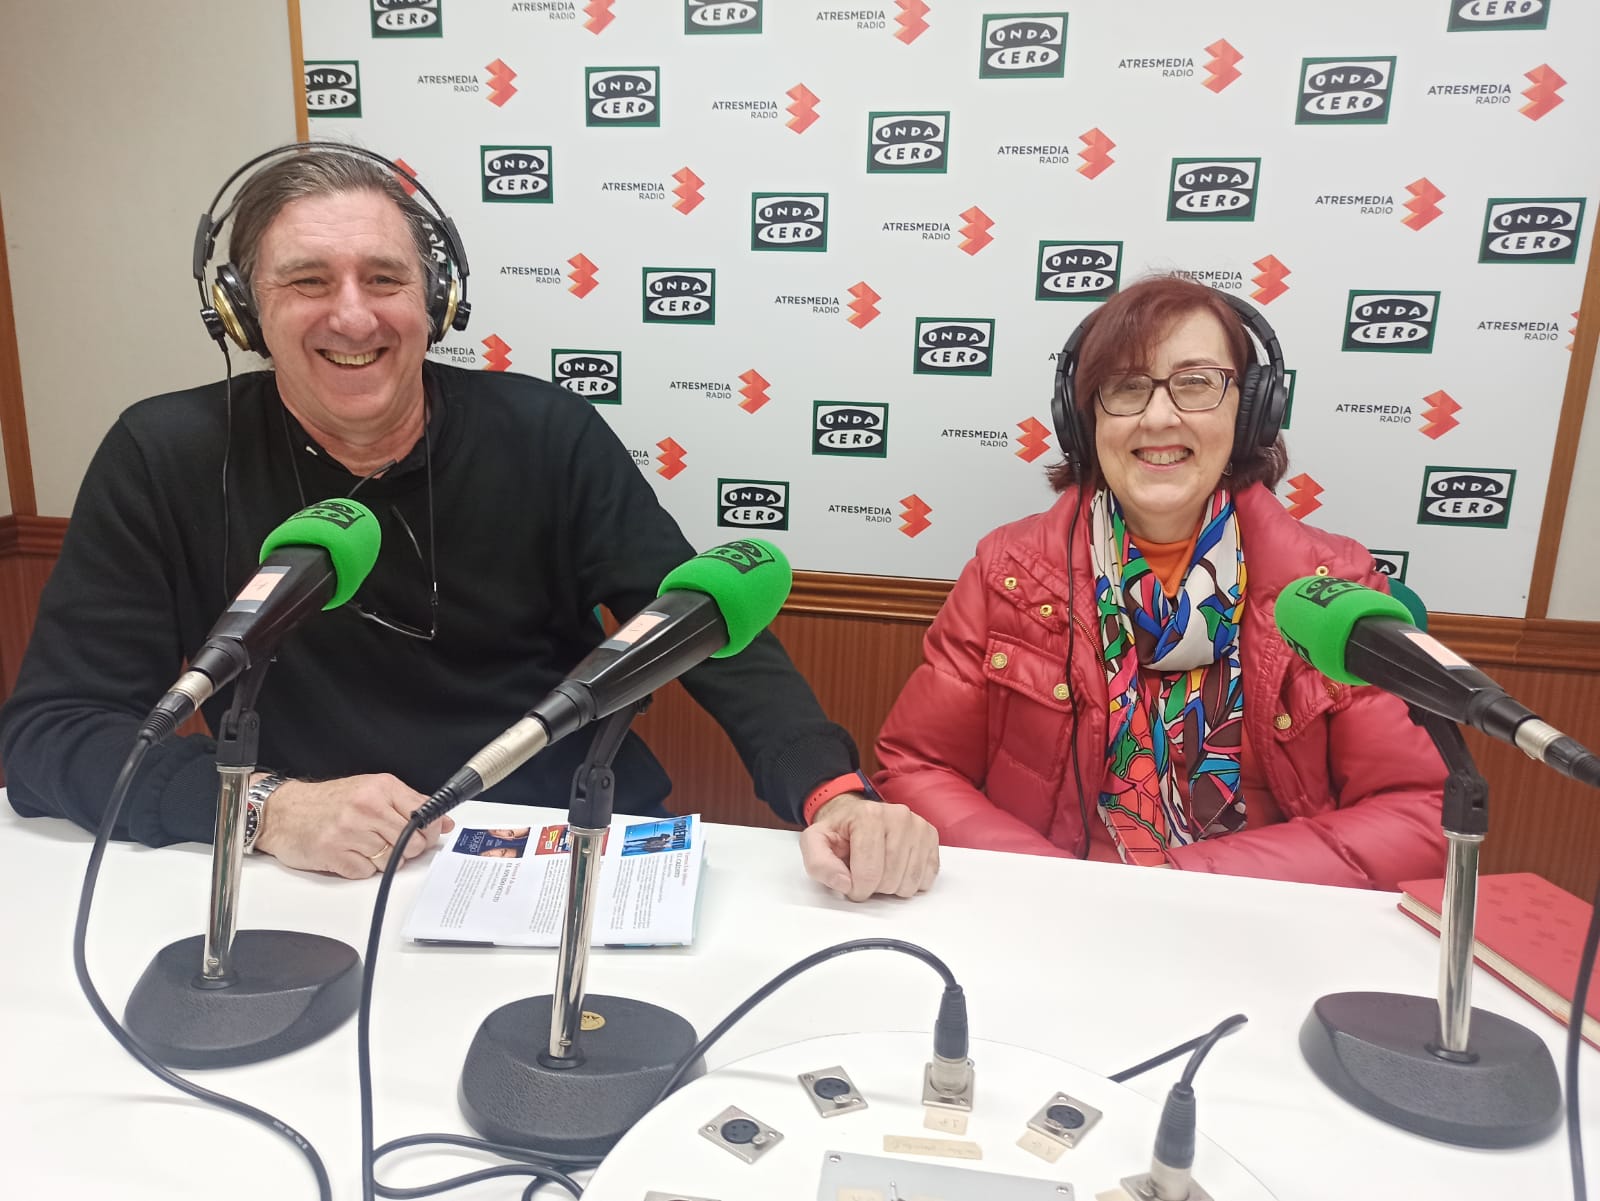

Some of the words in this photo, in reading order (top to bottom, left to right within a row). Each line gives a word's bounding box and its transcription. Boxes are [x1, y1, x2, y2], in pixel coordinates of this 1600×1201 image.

[512, 2, 575, 12] ATRESMEDIA
[1471, 1, 1531, 15] CERO
[386, 13, 428, 25] CERO
[549, 12, 576, 20] RADIO
[701, 8, 748, 20] CERO
[816, 10, 885, 20] ATRESMEDIA
[857, 20, 886, 29] RADIO
[996, 29, 1050, 41] ONDA
[998, 51, 1049, 64] CERO
[1118, 58, 1194, 68] ATRESMEDIA
[1162, 69, 1194, 77] RADIO
[418, 75, 478, 84] ATRESMEDIA
[1316, 74, 1375, 86] ONDA
[454, 84, 479, 92] RADIO
[598, 82, 646, 92] ONDA
[1428, 84, 1511, 95] ATRESMEDIA
[306, 95, 349, 105] CERO
[1316, 96, 1373, 110] CERO
[1476, 96, 1510, 104] RADIO
[601, 102, 646, 114] CERO
[712, 101, 778, 110] ATRESMEDIA
[751, 111, 778, 119] RADIO
[882, 127, 933, 138] ONDA
[884, 148, 932, 160] CERO
[998, 146, 1069, 154] ATRESMEDIA
[493, 160, 539, 170] ONDA
[1040, 156, 1069, 164] RADIO
[1186, 174, 1242, 184] ONDA
[497, 179, 539, 190] CERO
[602, 182, 664, 191] ATRESMEDIA
[1186, 195, 1240, 207] CERO
[1315, 196, 1393, 205] ATRESMEDIA
[765, 208, 813, 217] ONDA
[1501, 214, 1563, 226] ONDA
[882, 222, 950, 231] ATRESMEDIA
[767, 227, 813, 238] CERO
[1501, 236, 1560, 249] CERO
[1052, 256, 1105, 266] ONDA
[500, 266, 560, 276] ATRESMEDIA
[655, 282, 701, 291] ONDA
[1054, 276, 1104, 288] CERO
[1211, 281, 1242, 289] RADIO
[774, 296, 839, 305] ATRESMEDIA
[658, 301, 701, 311] CERO
[813, 306, 840, 314] RADIO
[1362, 306, 1420, 316] ONDA
[1477, 321, 1559, 331] ATRESMEDIA
[929, 332, 978, 342] ONDA
[1363, 327, 1418, 338] CERO
[930, 352, 978, 362] CERO
[564, 363, 608, 372] ONDA
[567, 381, 609, 392] CERO
[670, 381, 731, 391] ATRESMEDIA
[1336, 404, 1412, 414] ATRESMEDIA
[826, 415, 873, 424] ONDA
[828, 434, 873, 444] CERO
[941, 429, 1008, 439] ATRESMEDIA
[1438, 482, 1496, 492] ONDA
[730, 492, 775, 502] ONDA
[828, 505, 891, 515] ATRESMEDIA
[1438, 502, 1493, 513] CERO
[732, 510, 775, 520] CERO
